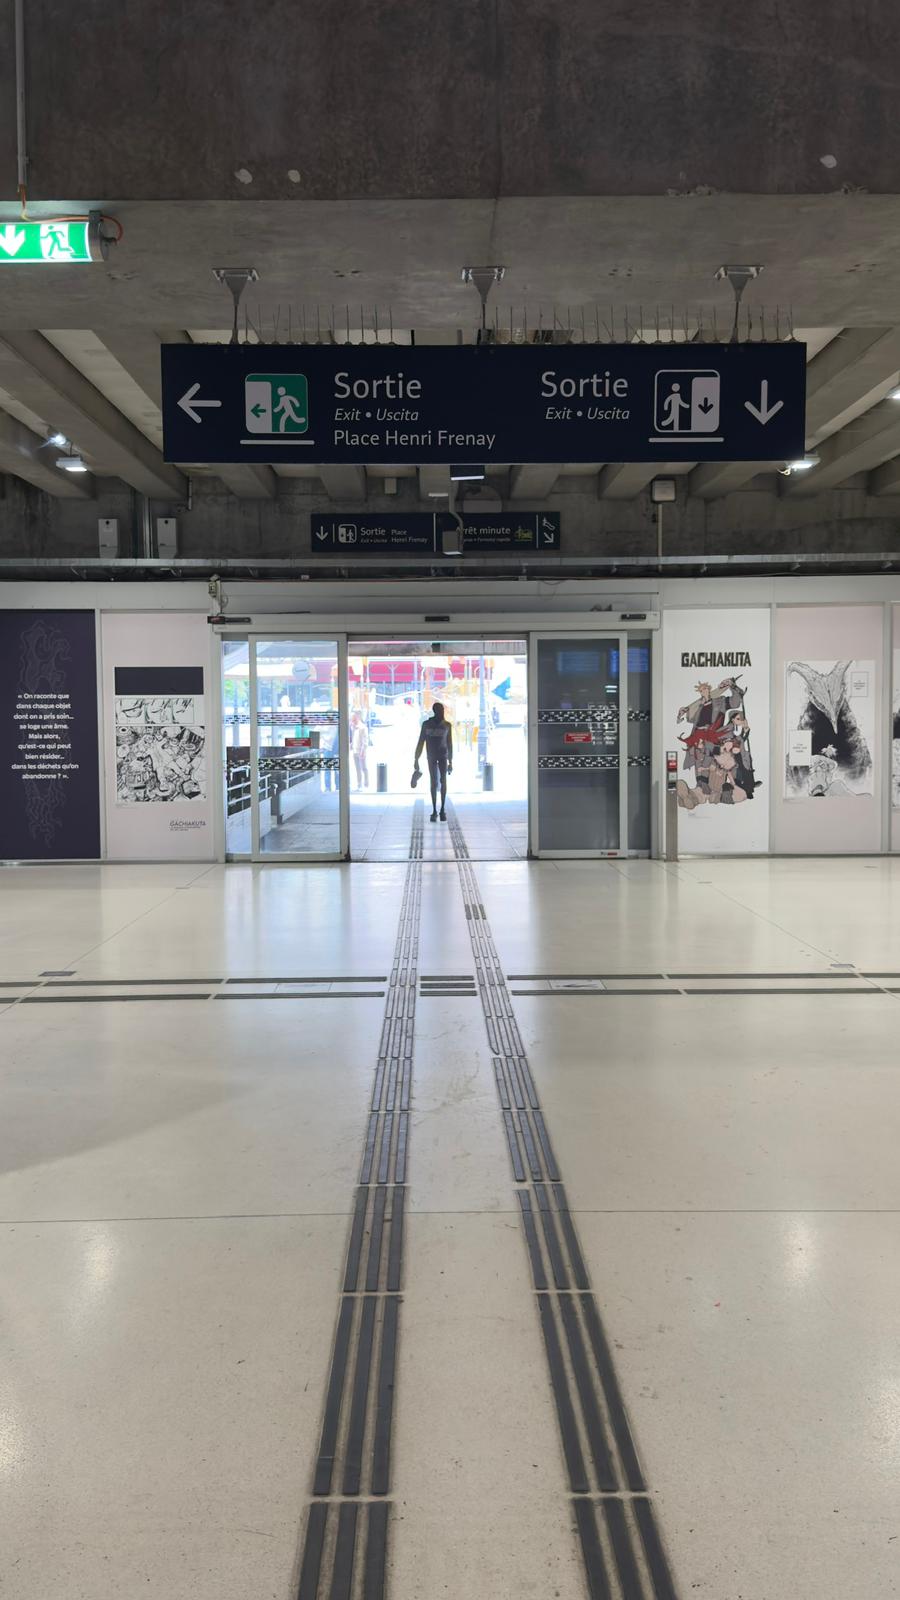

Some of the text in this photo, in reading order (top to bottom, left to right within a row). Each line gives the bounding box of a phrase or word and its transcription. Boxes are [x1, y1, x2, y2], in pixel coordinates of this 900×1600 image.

[334, 372, 422, 399] Sortie
[541, 370, 629, 398] Sortie
[334, 408, 361, 421] Exit
[376, 408, 419, 421] Uscita
[545, 406, 573, 420] Exit
[587, 406, 630, 420] Uscita
[334, 430, 496, 450] Place Henri Frenay
[360, 527, 386, 536] Sortie
[479, 526, 511, 535] minute
[681, 651, 752, 668] GACHIAKUTA
[23, 692, 33, 700] On
[58, 693, 70, 701] que
[16, 702, 72, 711] dans chaque objet
[13, 712, 29, 720] dont
[43, 711, 56, 721] pris
[19, 723, 27, 731] se
[27, 723, 41, 731] loge
[53, 722, 70, 730] âme.
[43, 732, 61, 741] alors,
[46, 743, 57, 751] qui
[57, 743, 72, 751] peut
[22, 772, 57, 780] abandonne
